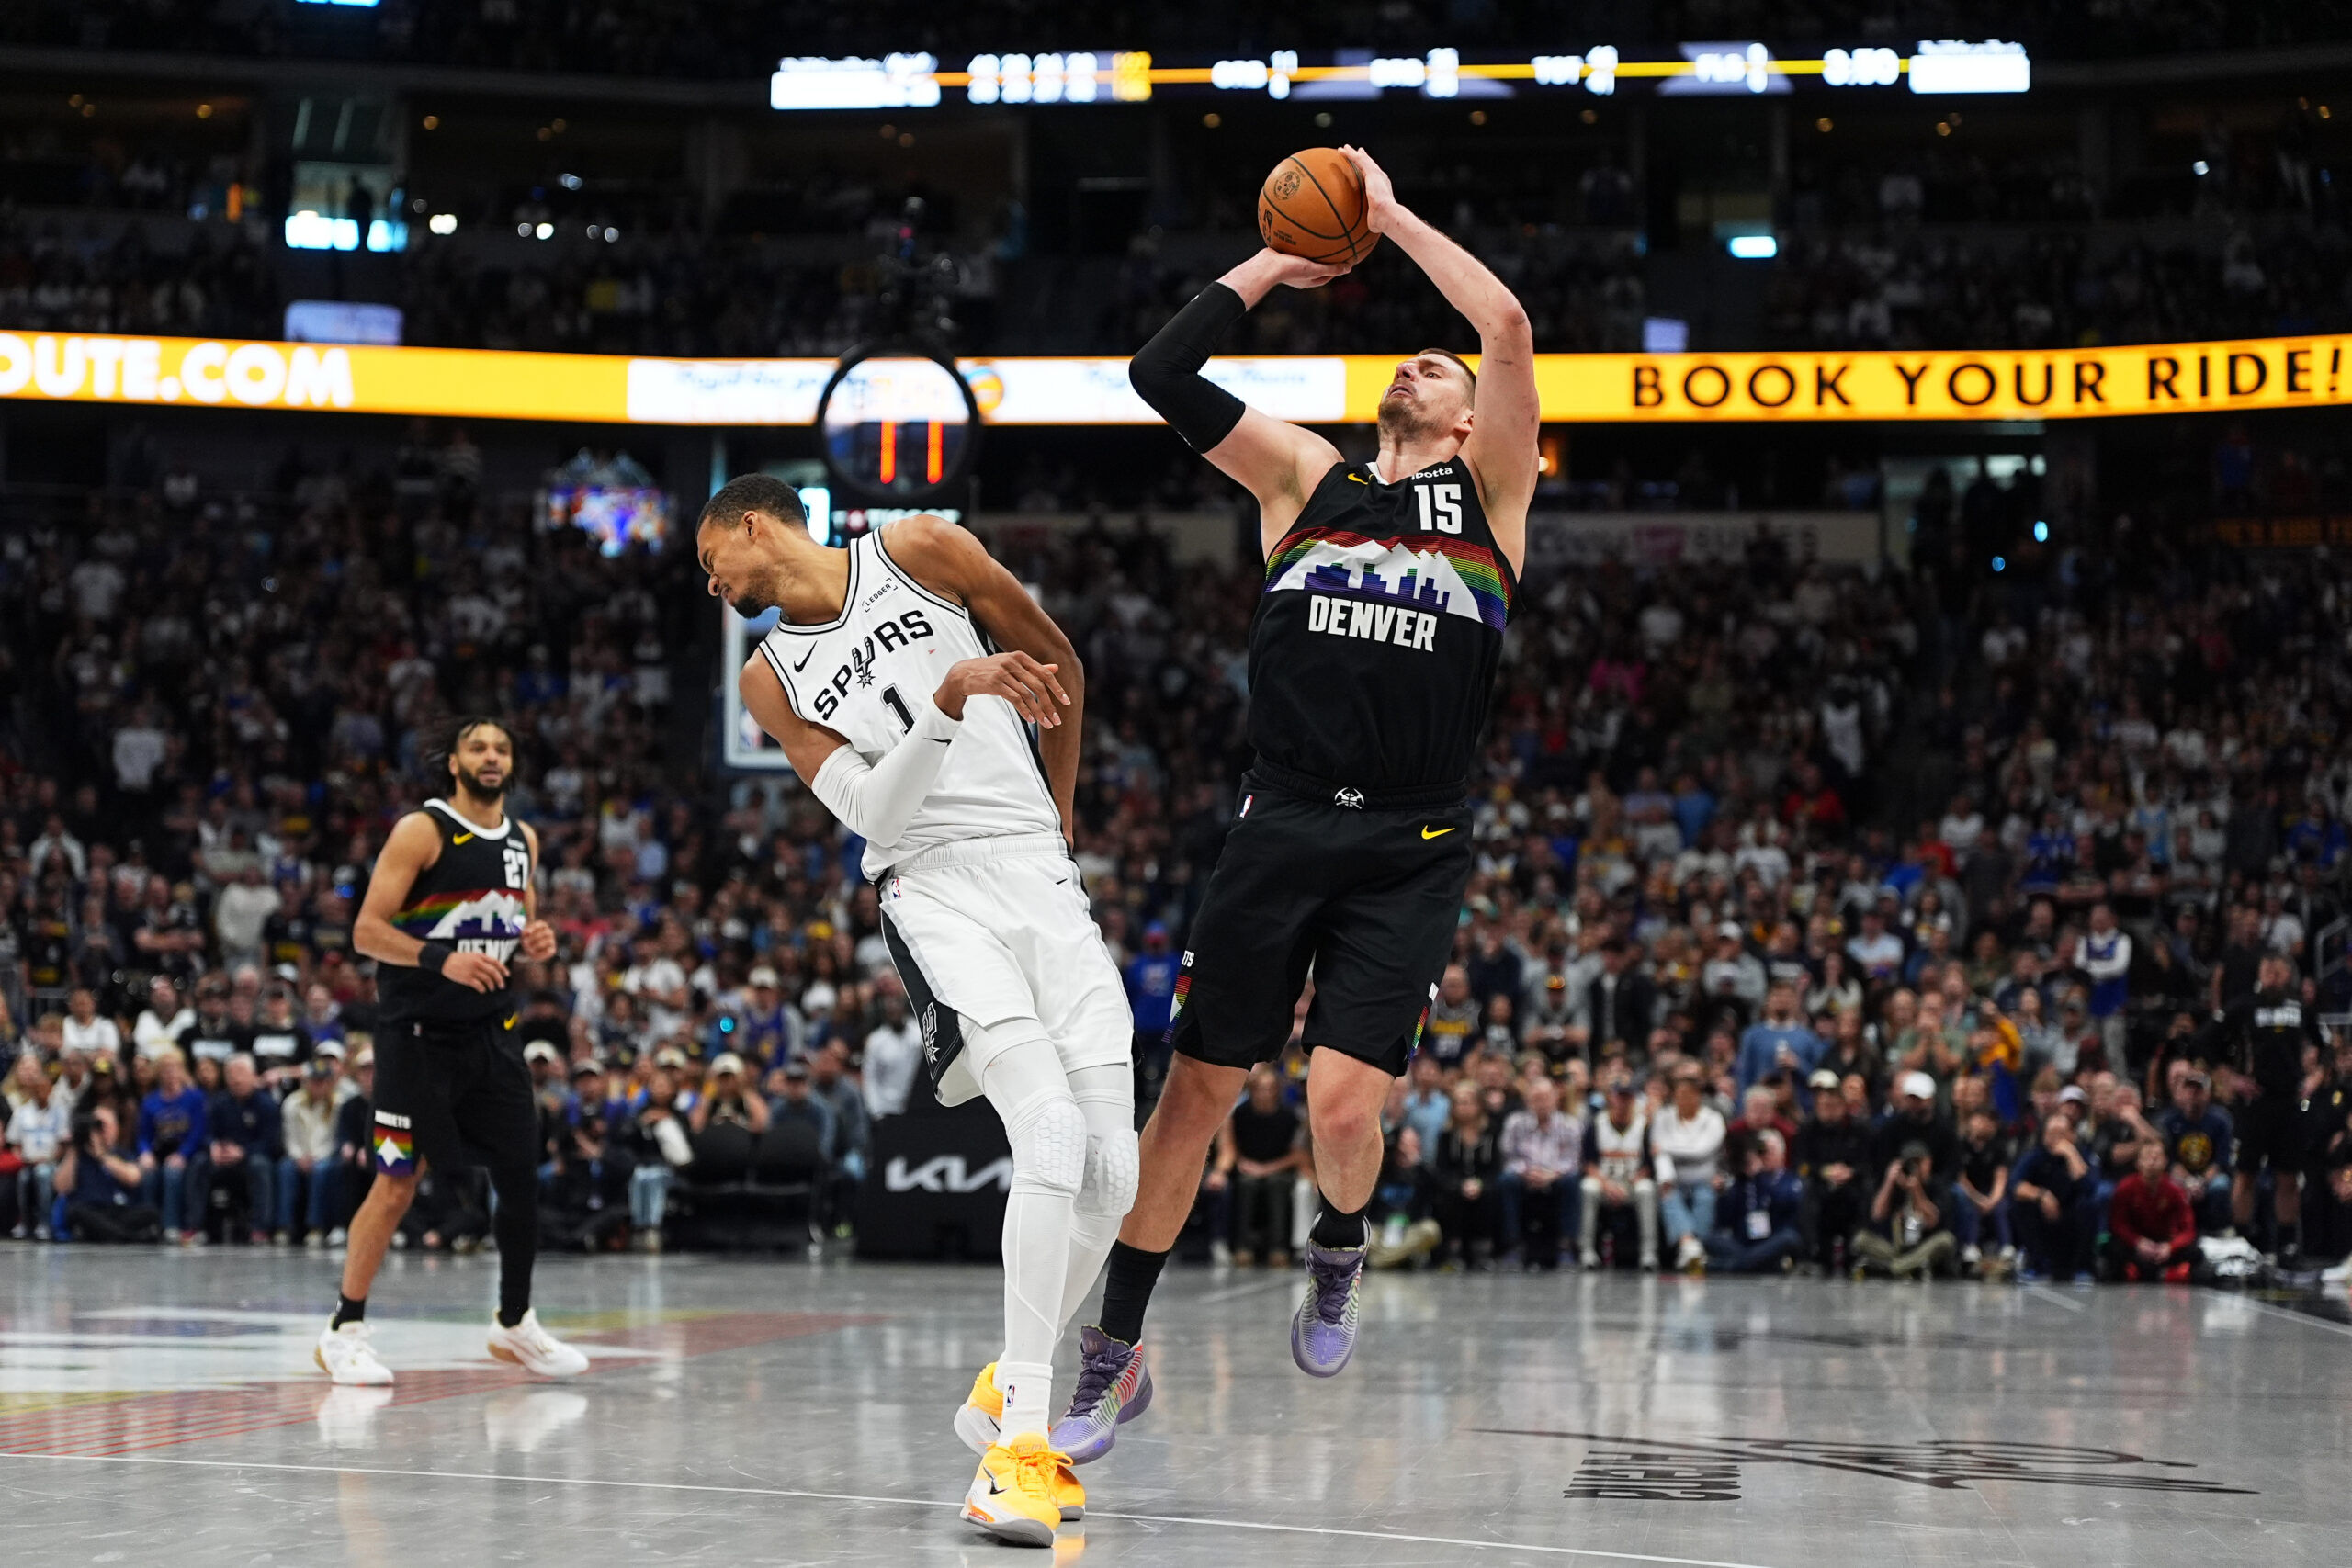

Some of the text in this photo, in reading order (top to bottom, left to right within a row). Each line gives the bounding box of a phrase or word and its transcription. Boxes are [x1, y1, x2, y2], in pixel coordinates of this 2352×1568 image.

[1634, 348, 2340, 406] BOOK YOUR RIDE!
[1414, 484, 1462, 534] 15
[865, 583, 892, 606] LEDGER
[1308, 595, 1437, 652] DENVER
[814, 610, 933, 721] SPURS
[880, 683, 916, 737] 1
[503, 848, 529, 891] 27
[885, 1156, 1013, 1193] KIA
